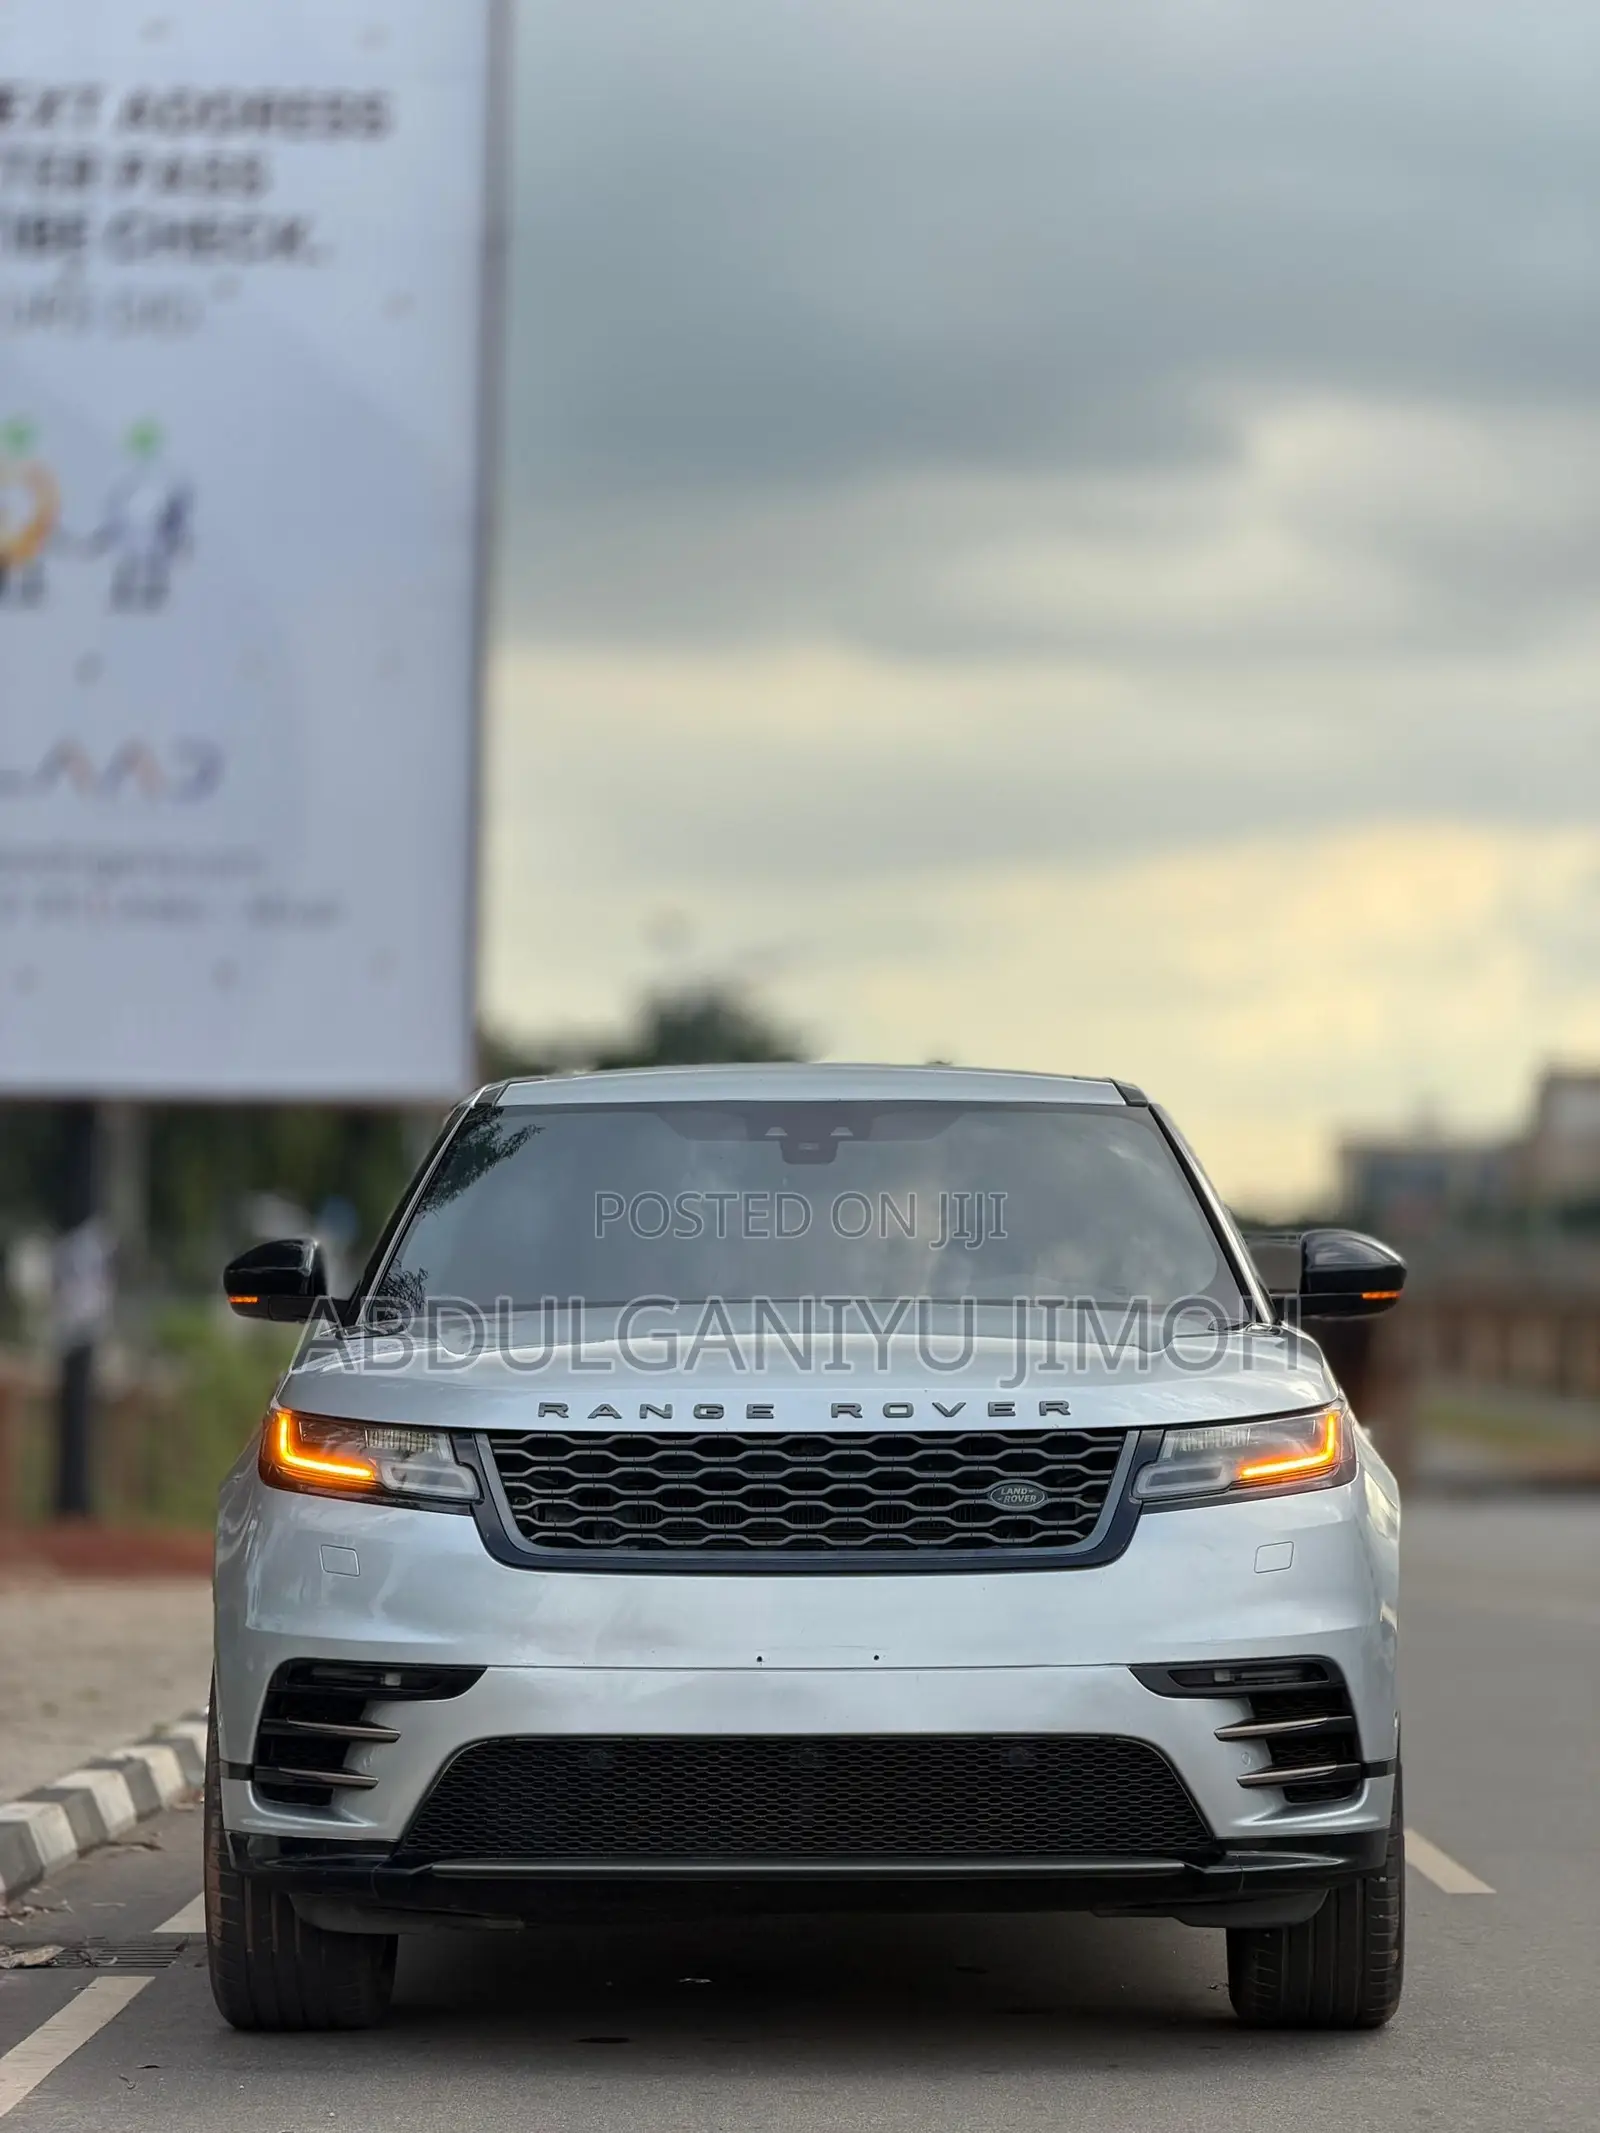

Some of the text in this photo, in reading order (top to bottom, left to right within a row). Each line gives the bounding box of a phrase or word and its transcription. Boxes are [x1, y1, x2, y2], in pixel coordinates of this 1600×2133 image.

[119, 87, 391, 140] ADDRESS
[116, 151, 268, 197] PASS
[537, 1400, 1072, 1420] RANGE ROVER
[1004, 1494, 1037, 1503] ROVER
